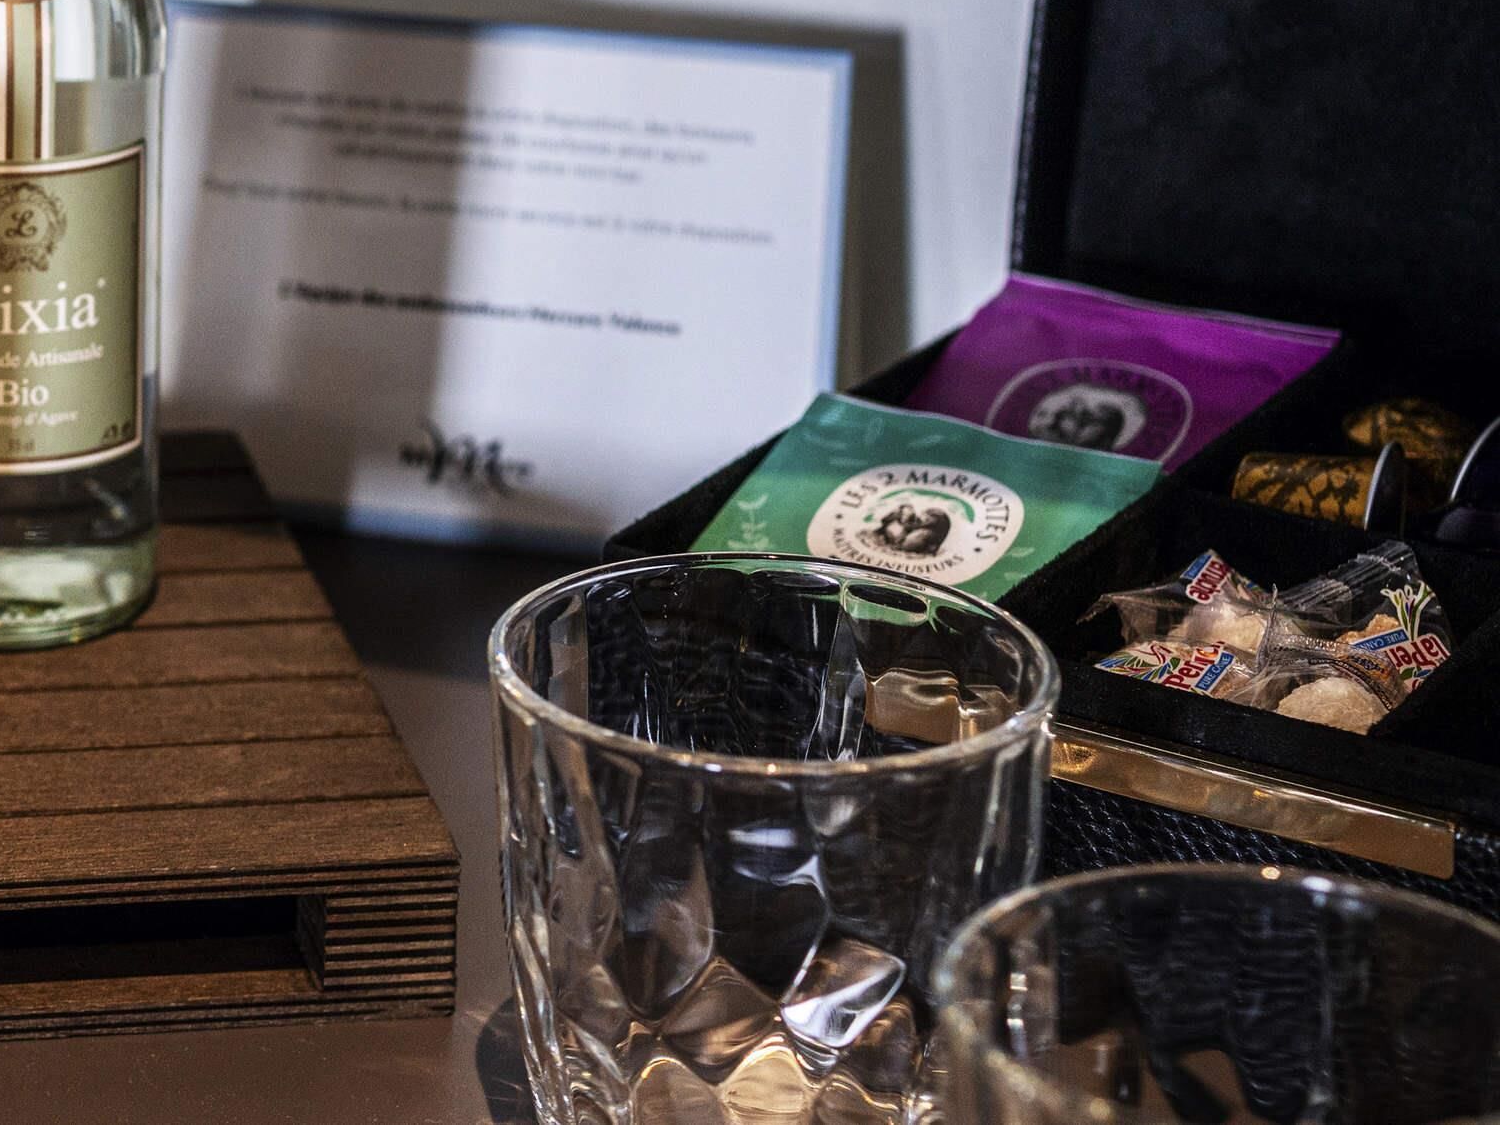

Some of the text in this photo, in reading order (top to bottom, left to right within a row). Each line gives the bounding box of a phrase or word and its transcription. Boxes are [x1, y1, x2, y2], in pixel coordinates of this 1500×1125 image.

[841, 469, 1011, 544] LES 2 MARMOTTES
